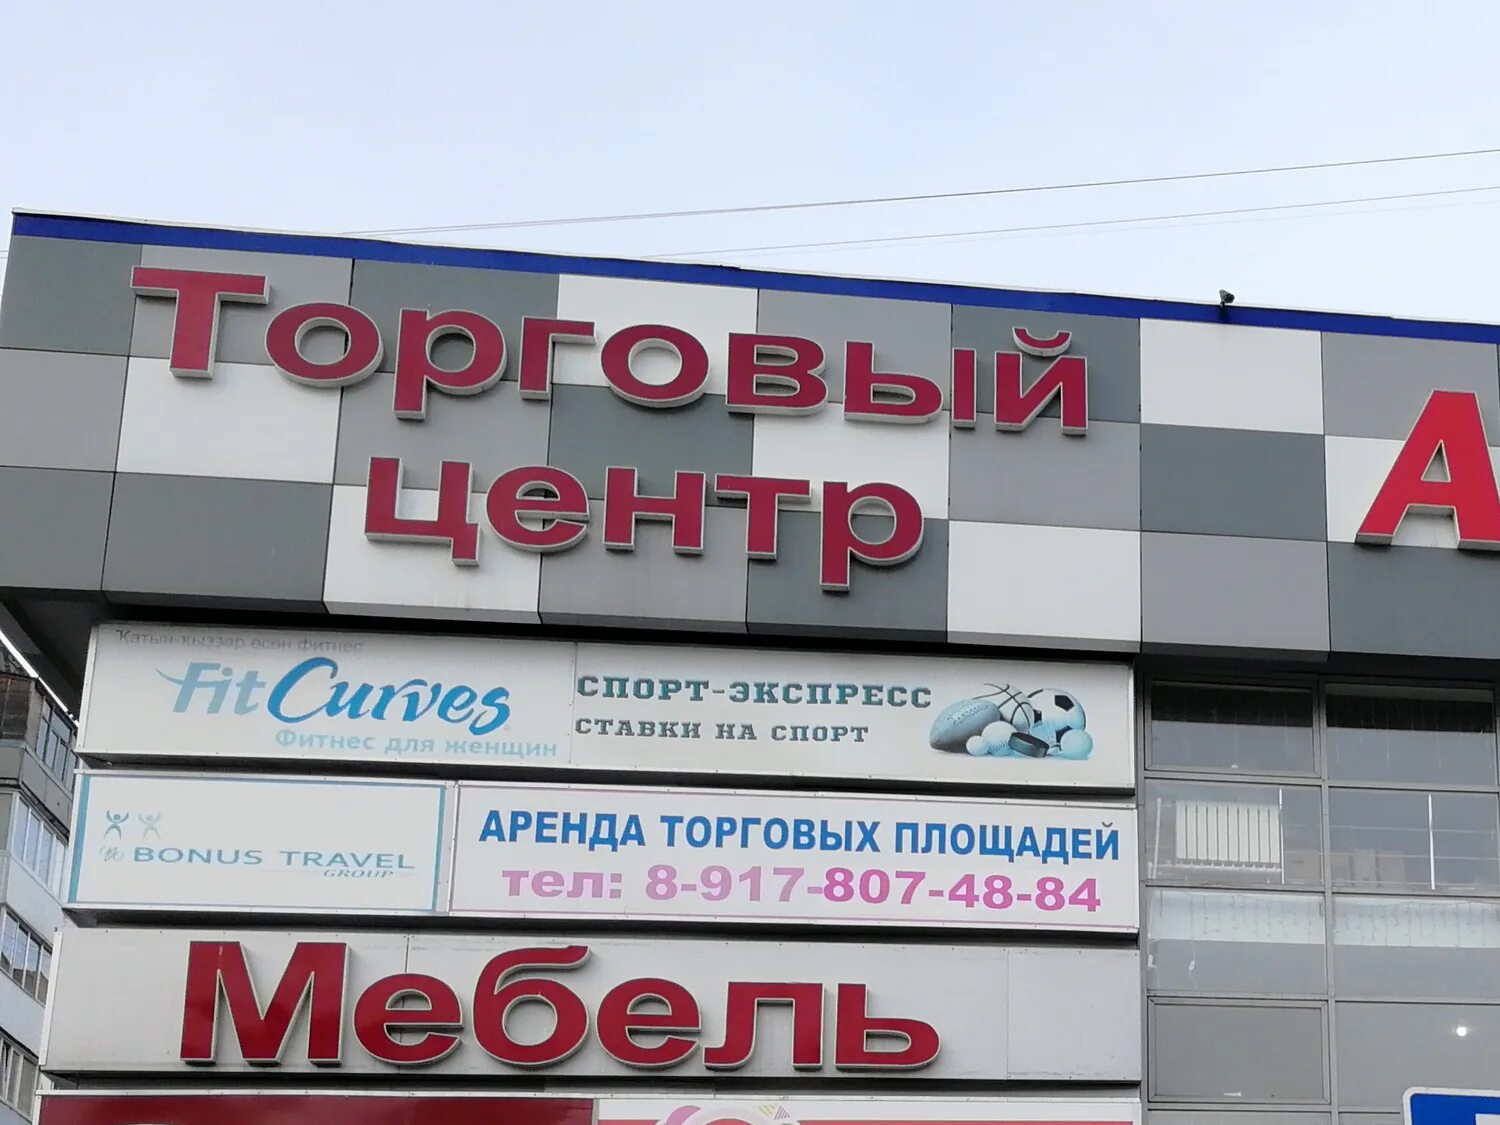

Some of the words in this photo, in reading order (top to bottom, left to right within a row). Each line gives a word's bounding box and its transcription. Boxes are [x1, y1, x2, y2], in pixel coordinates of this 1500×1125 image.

[130, 265, 1091, 437] Торговый
[363, 455, 925, 592] центр
[576, 675, 932, 709] СПОРТ-ЭКСПРЕСС
[274, 728, 375, 751] Фитнес
[384, 736, 435, 755] для
[443, 738, 558, 759] женщин
[715, 722, 758, 741] НА
[770, 724, 870, 743] СПОРТ
[478, 809, 647, 853] АРЕНДА
[659, 813, 882, 855] ТОРГОВЫХ
[894, 821, 1121, 865] ПЛОЩАДЕЙ
[133, 846, 263, 866] BONUS
[279, 848, 416, 870] TRAVEL
[322, 867, 395, 880] GROUP
[501, 869, 624, 900] тел:
[645, 864, 1102, 913] 8-917-807-48-84
[179, 940, 942, 1071] Мебель
